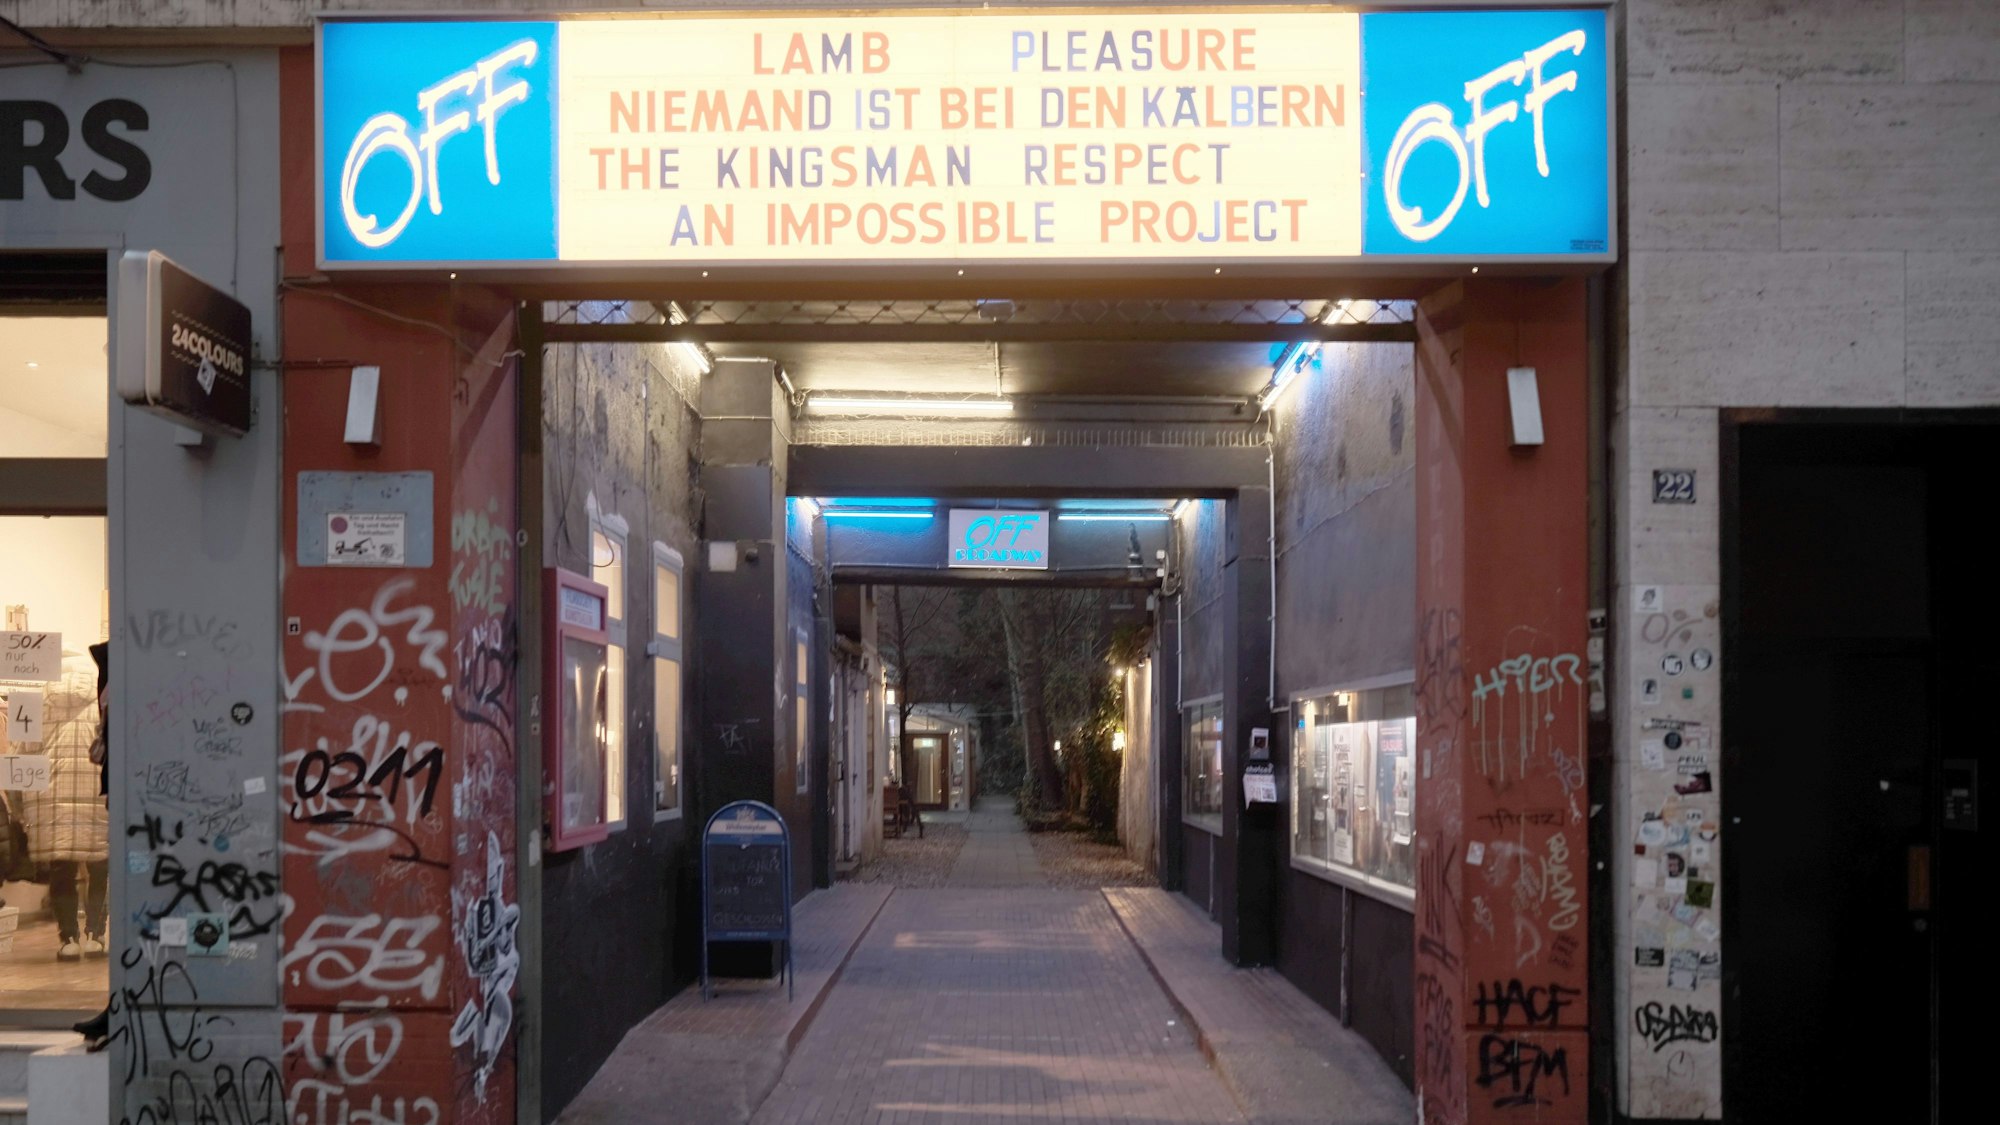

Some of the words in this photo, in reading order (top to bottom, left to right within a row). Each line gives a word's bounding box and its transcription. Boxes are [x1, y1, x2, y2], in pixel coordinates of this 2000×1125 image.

[753, 33, 891, 75] LAMB
[1012, 28, 1257, 71] PLEASURE
[609, 90, 832, 132] NIEMAND
[855, 88, 921, 130] IST
[940, 86, 1015, 130] BEI
[1041, 85, 1127, 129] DEN
[1142, 84, 1346, 128] KÄLBERN
[341, 39, 537, 248] OFF
[1384, 29, 1587, 242] OFF
[589, 147, 680, 191] THE
[717, 145, 972, 189] KINGSMAN
[1024, 142, 1231, 187] RESPECT
[670, 203, 735, 247] AN
[766, 202, 1055, 245] IMPOSSIBLE
[1100, 199, 1309, 243] PROJECT
[171, 323, 244, 377] 24COLOURS
[1658, 471, 1692, 499] 22
[964, 513, 1041, 549] OFF
[955, 548, 1044, 562] BROADWAY
[5, 651, 27, 662] nur
[8, 633, 48, 650] 50%
[13, 660, 41, 674] noch
[15, 704, 33, 733] 4
[3, 756, 47, 788] Tage
